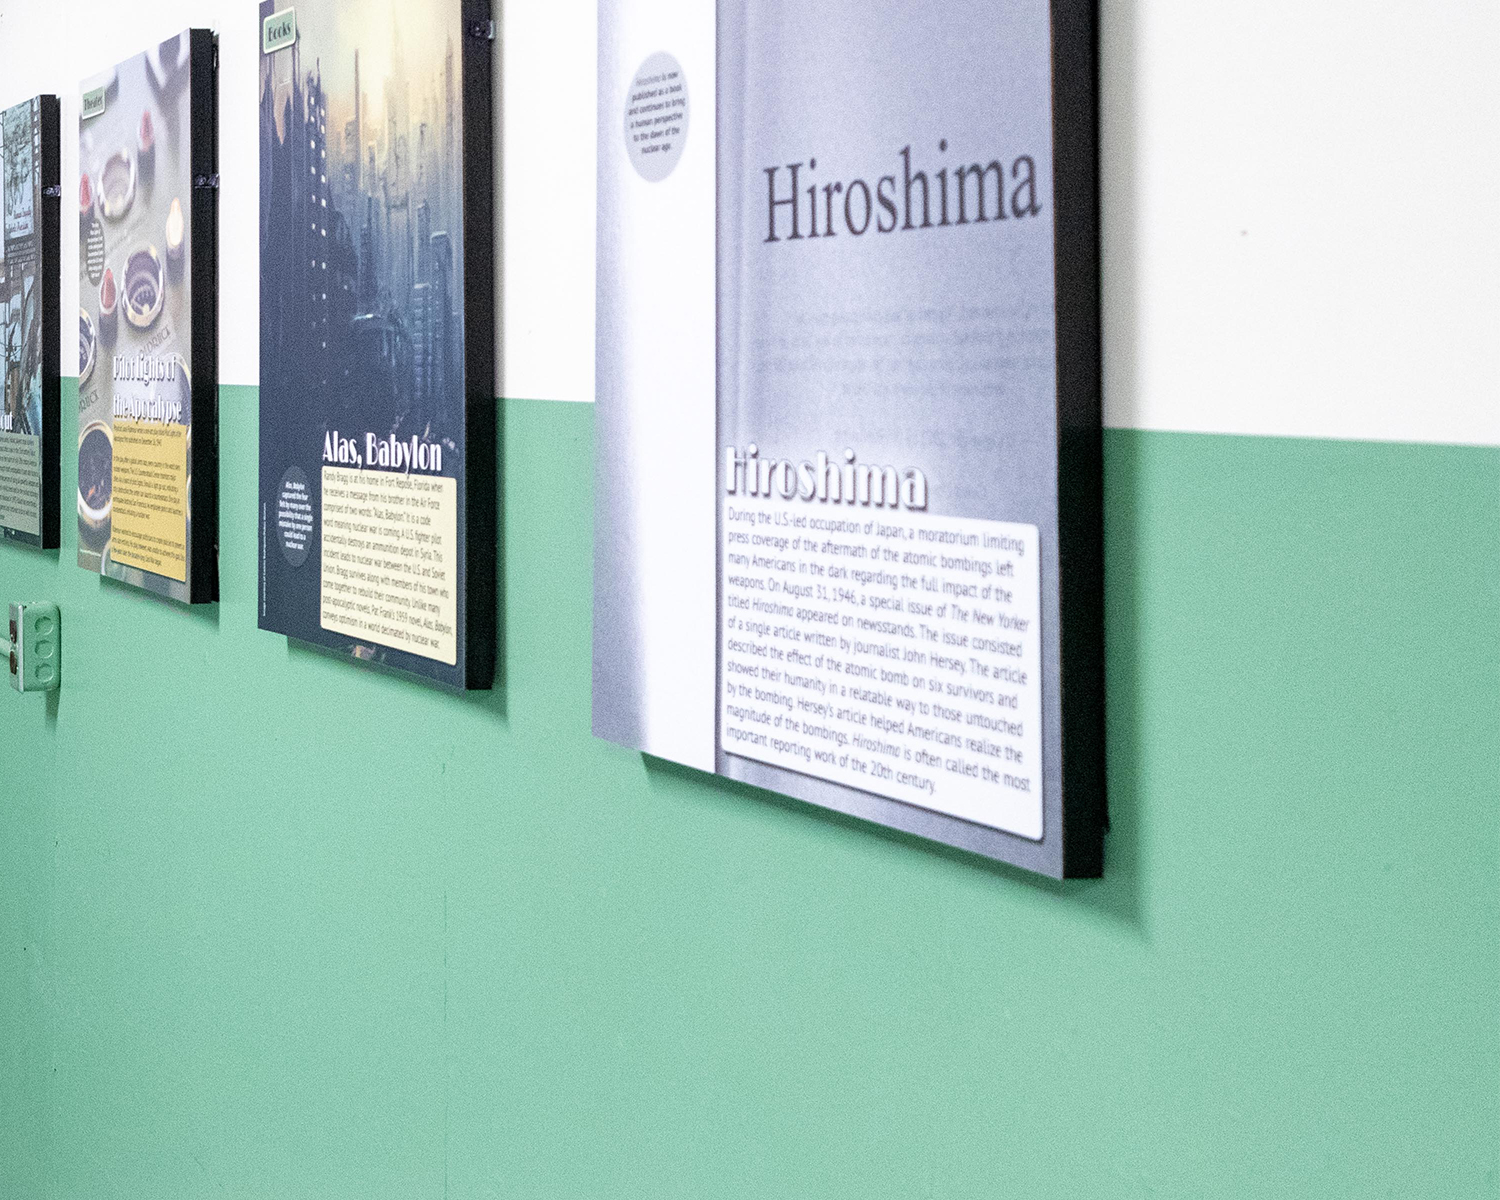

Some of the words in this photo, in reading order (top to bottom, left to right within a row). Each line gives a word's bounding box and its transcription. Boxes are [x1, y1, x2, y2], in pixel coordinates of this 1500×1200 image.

[269, 22, 290, 42] Books
[763, 139, 1042, 243] Hiroshima
[114, 354, 134, 380] Pilot
[136, 354, 164, 386] Lights
[166, 356, 176, 381] of
[114, 394, 129, 418] the
[130, 394, 182, 425] Apocalypse
[322, 430, 362, 468] Alas,
[366, 432, 441, 475] Babylon
[726, 444, 928, 512] Hiroshima
[728, 506, 756, 526] During
[758, 512, 771, 525] the
[774, 512, 807, 528] U.S.-led
[810, 519, 861, 533] occupation
[864, 521, 874, 535] of
[876, 524, 906, 540] Japan,
[909, 528, 914, 540] a
[918, 529, 979, 546] moratorium
[982, 535, 1025, 554] limiting
[728, 532, 749, 544] press
[752, 535, 789, 552] coverage
[792, 536, 800, 550] of
[804, 539, 818, 552] the
[821, 540, 867, 558] aftermath
[870, 546, 880, 560] of
[883, 548, 899, 562] the
[903, 552, 936, 567] atomic
[940, 556, 992, 577] bombings
[995, 561, 1014, 577] left
[728, 553, 750, 568] many
[752, 555, 796, 572] Americans
[799, 563, 807, 573] in
[810, 563, 824, 576] the
[828, 566, 848, 579] dark
[851, 570, 898, 590] regarding
[901, 575, 918, 589] the
[921, 575, 938, 592] full
[942, 582, 978, 598] impact
[981, 584, 992, 600] of
[994, 588, 1013, 603] the
[728, 596, 750, 610] titled
[752, 599, 794, 617] Hiroshima
[796, 608, 839, 624] appeared
[842, 615, 854, 627] on
[857, 618, 917, 638] newsstands.
[920, 624, 938, 642] The
[942, 633, 968, 647] issue
[972, 638, 1022, 657] consisted
[768, 577, 780, 592] On
[783, 582, 813, 599] August
[861, 594, 866, 606] a
[869, 596, 904, 611] special
[907, 602, 933, 616] issue
[936, 603, 947, 618] of
[952, 604, 969, 622] The
[972, 609, 995, 625] New
[998, 614, 1029, 632] Yorker
